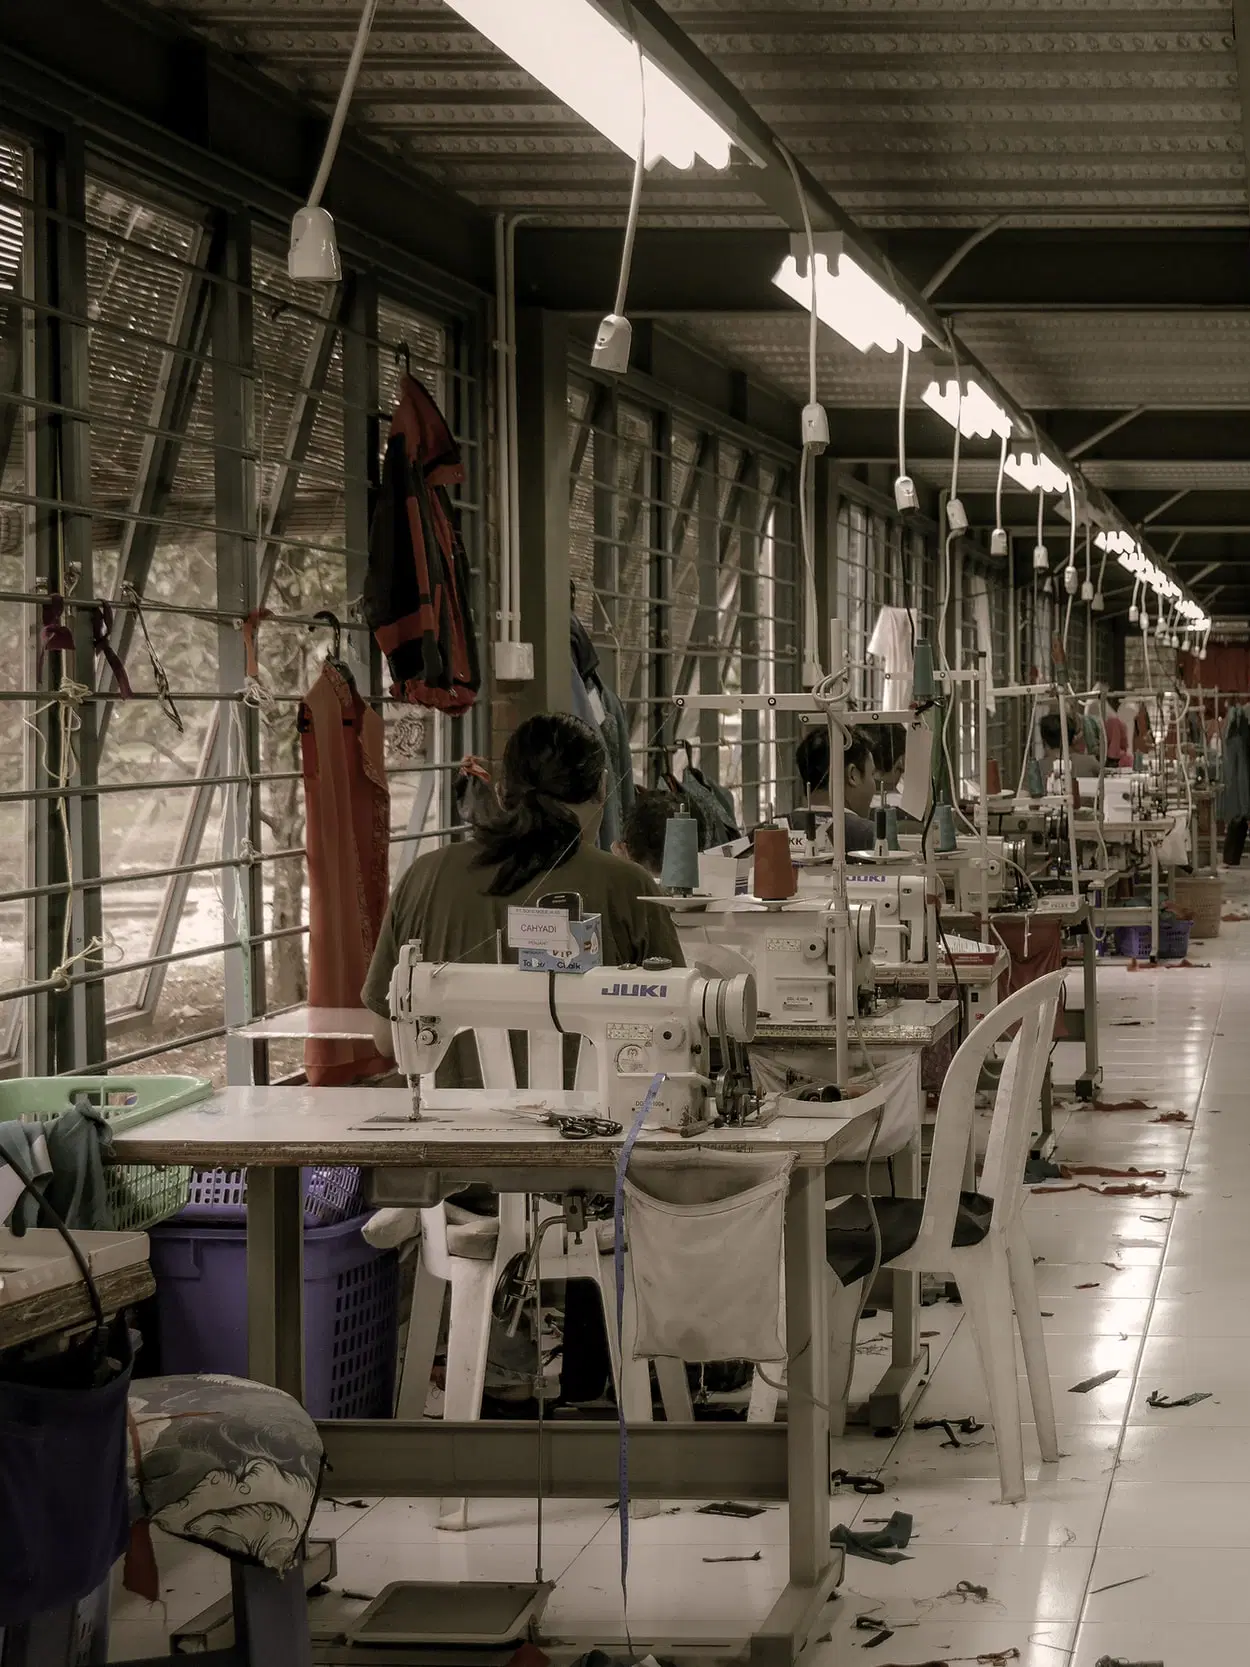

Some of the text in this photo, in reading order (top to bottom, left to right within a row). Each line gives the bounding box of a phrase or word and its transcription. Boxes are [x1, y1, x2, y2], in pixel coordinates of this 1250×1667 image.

[520, 923, 557, 933] CAHYADI
[552, 949, 573, 958] VIP
[601, 983, 668, 998] JUKI
